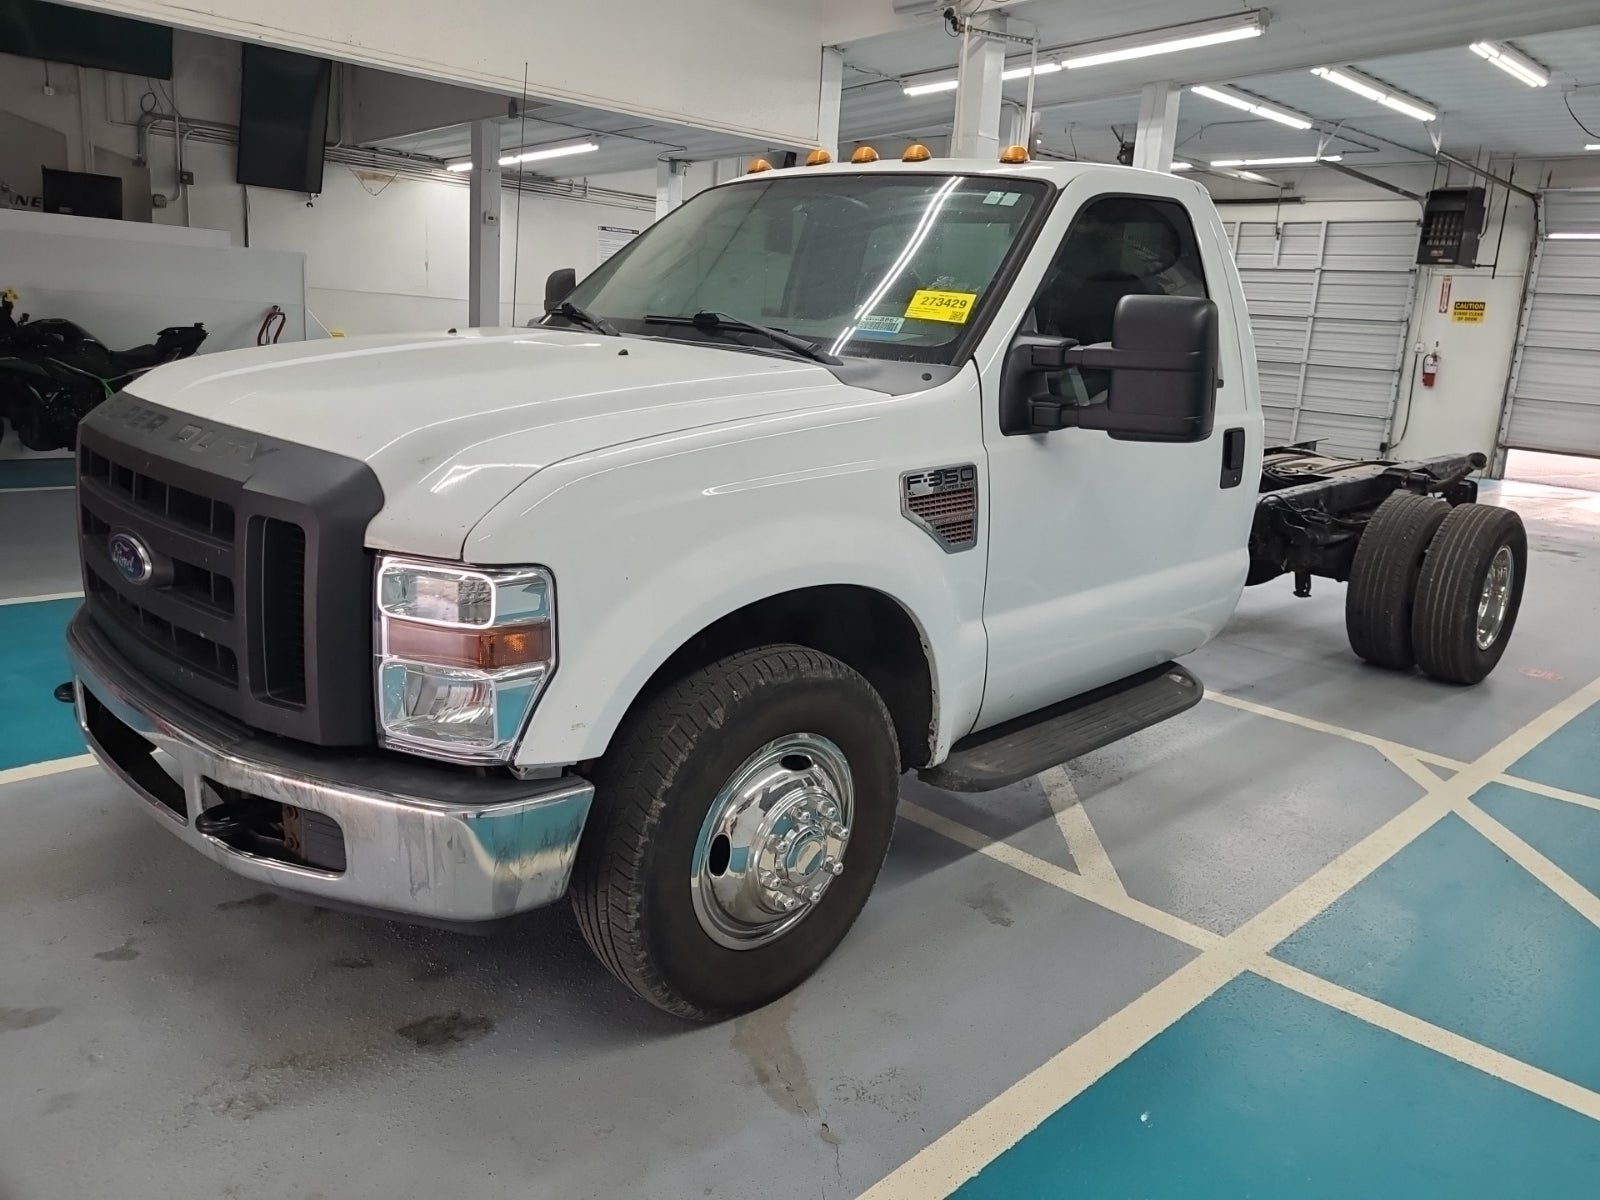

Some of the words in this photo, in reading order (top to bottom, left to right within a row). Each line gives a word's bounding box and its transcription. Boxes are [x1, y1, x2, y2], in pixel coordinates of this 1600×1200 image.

[920, 296, 968, 309] 273429
[1455, 302, 1485, 310] CAUTION
[906, 467, 974, 490] F-350
[112, 541, 134, 572] Ford
